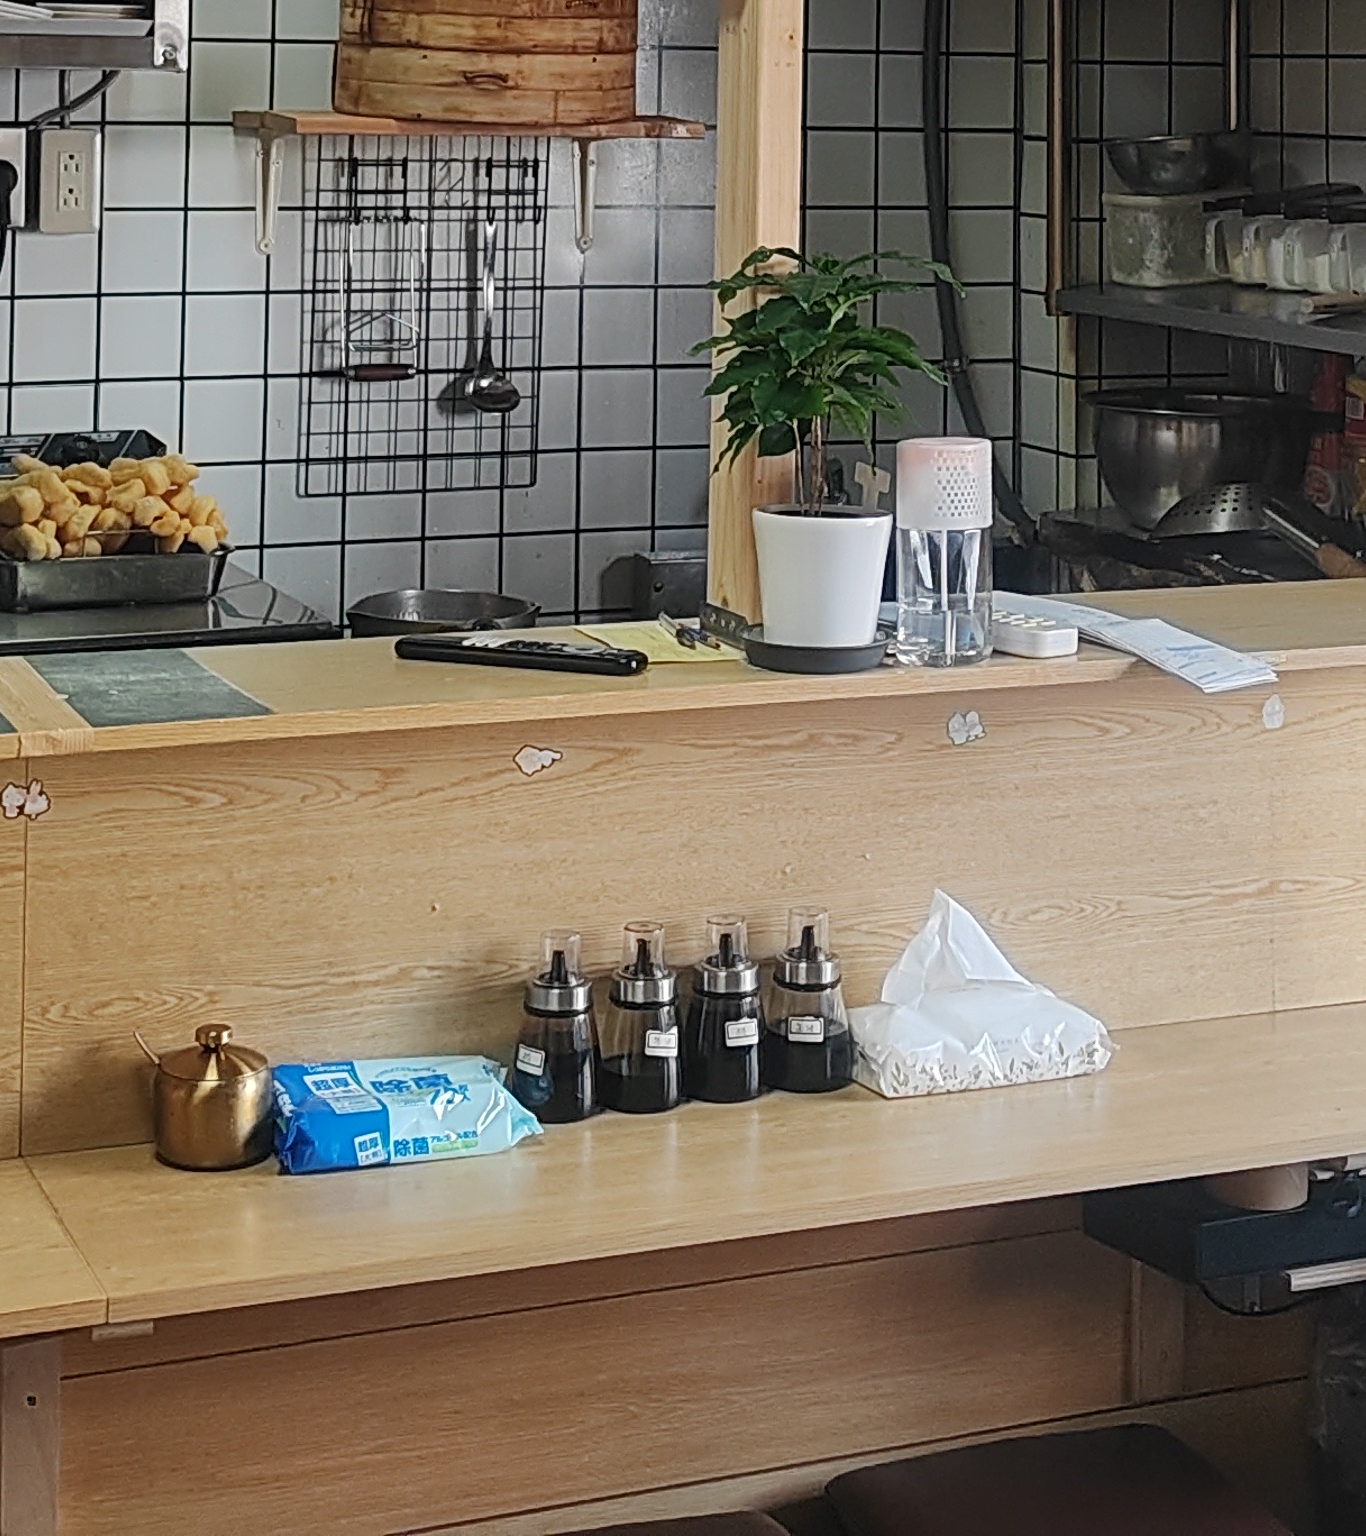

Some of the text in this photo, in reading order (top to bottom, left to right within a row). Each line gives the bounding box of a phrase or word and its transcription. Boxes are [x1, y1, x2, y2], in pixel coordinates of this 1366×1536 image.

[430, 1129, 479, 1143] アルコル配合
[393, 1138, 430, 1158] 除菌
